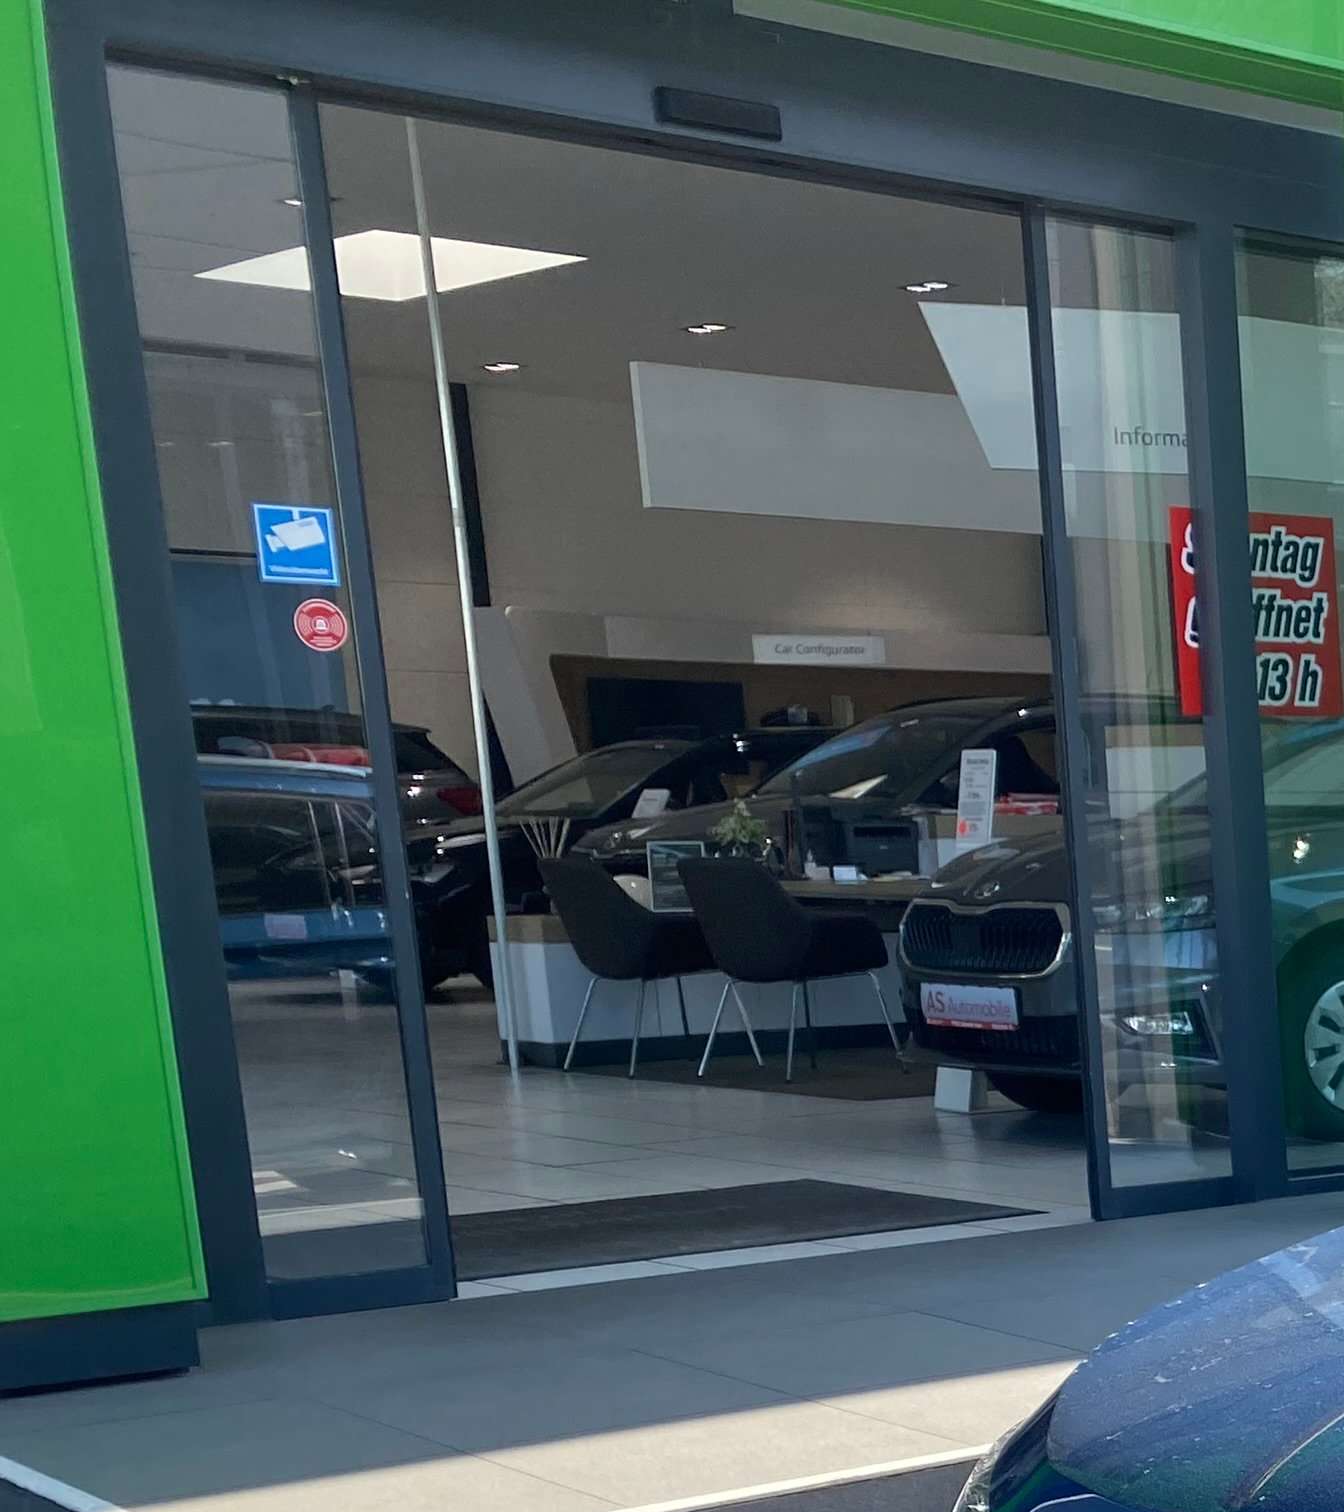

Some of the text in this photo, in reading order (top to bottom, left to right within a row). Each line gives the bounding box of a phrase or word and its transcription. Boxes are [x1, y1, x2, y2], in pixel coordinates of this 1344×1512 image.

[774, 643, 865, 656] Car Configurator
[1297, 657, 1321, 703] h
